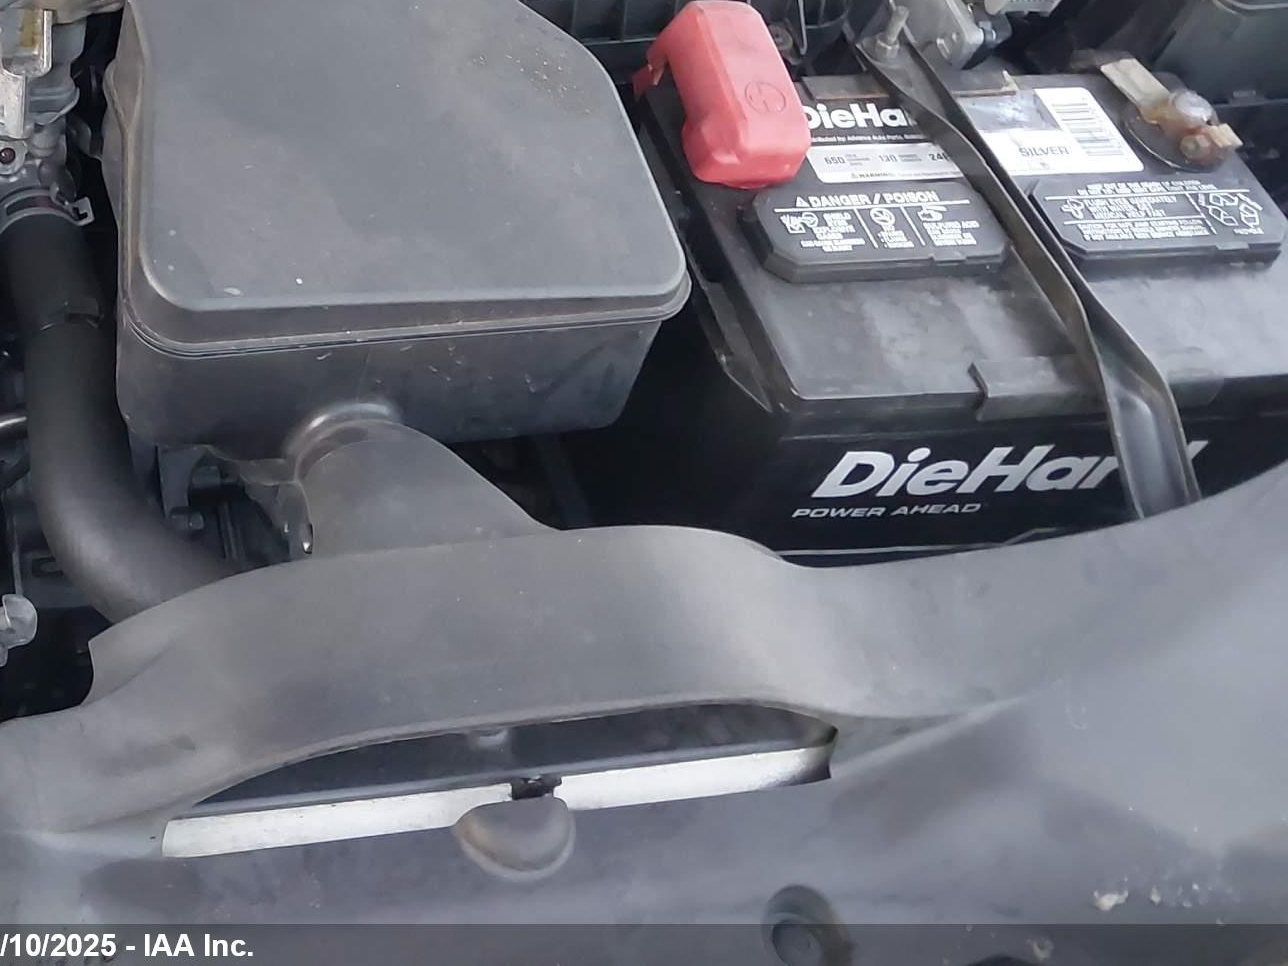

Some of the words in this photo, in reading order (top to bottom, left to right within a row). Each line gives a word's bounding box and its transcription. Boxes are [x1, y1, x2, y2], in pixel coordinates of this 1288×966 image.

[808, 194, 872, 207] DANGER
[884, 190, 941, 204] POISON
[811, 439, 1210, 498] DieHar
[791, 506, 886, 518] POWER
[889, 503, 982, 516] AHEAD
